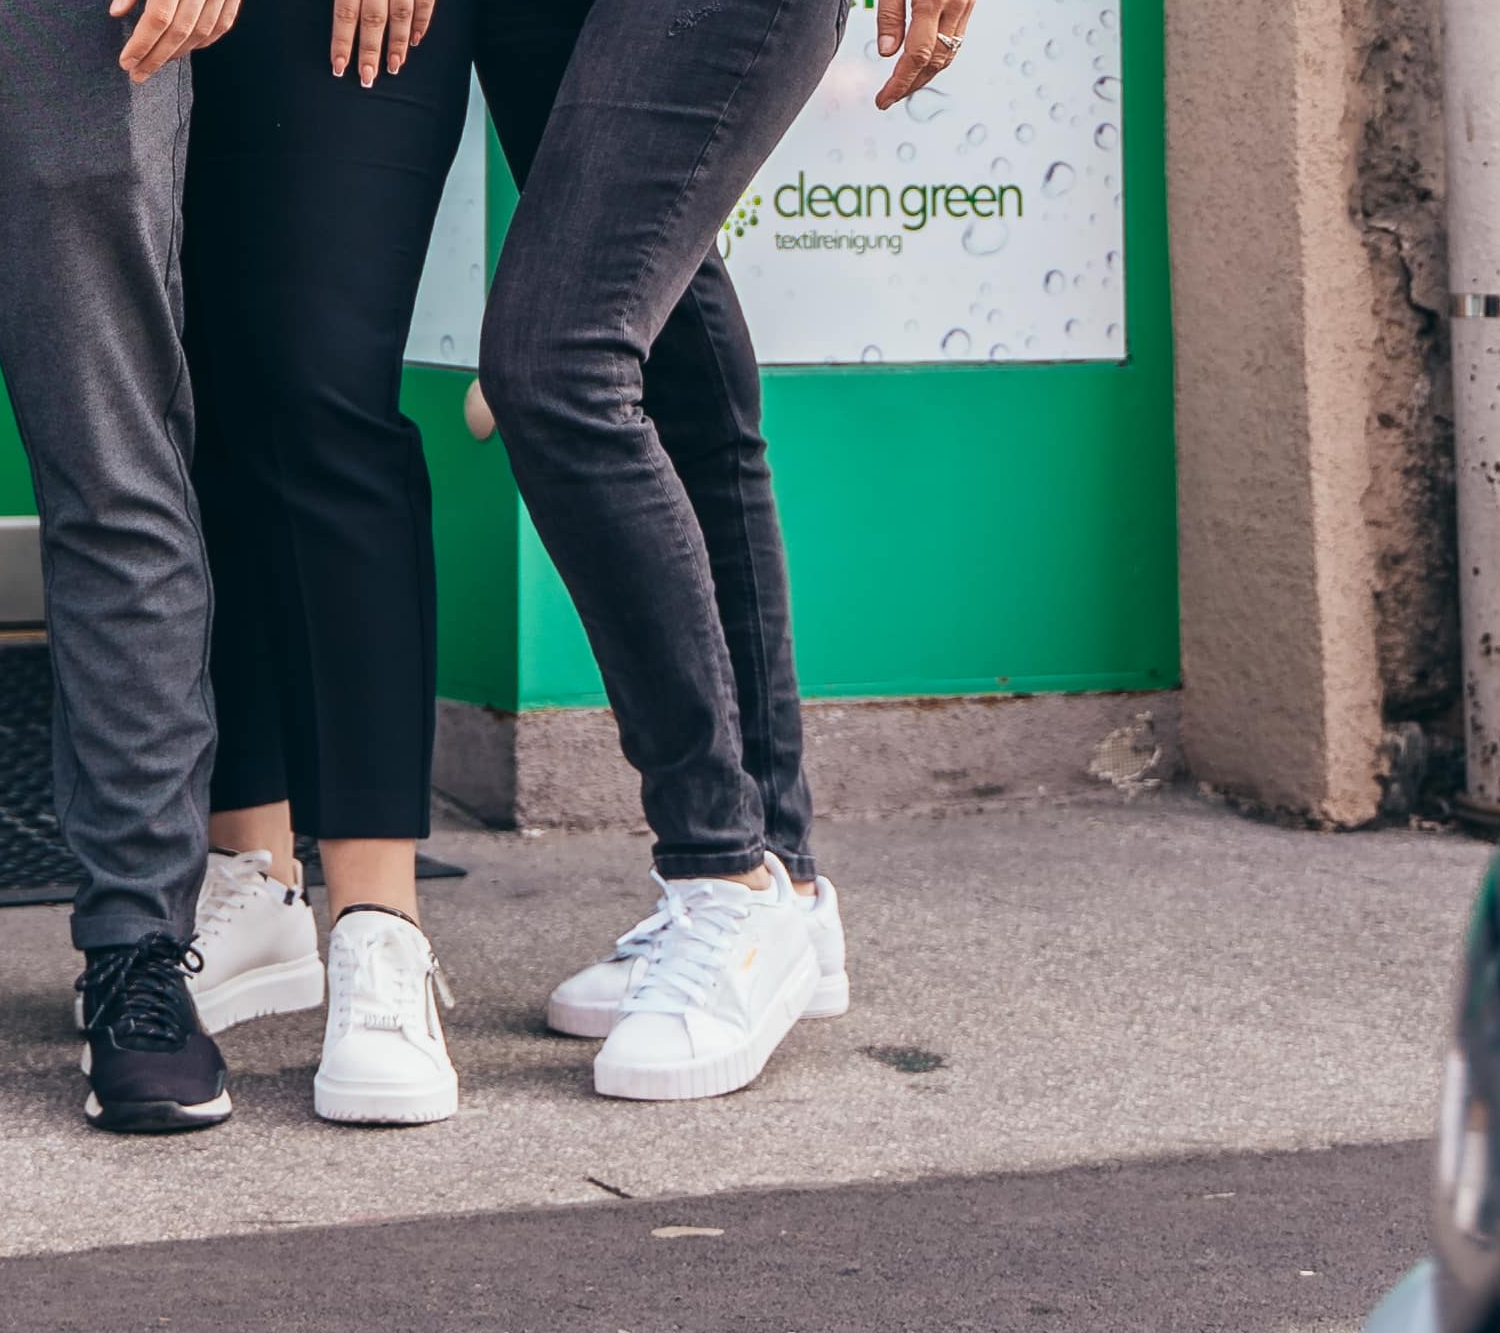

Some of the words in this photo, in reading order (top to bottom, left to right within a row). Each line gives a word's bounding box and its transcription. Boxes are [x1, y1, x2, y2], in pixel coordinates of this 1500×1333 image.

[774, 170, 892, 219] clean
[899, 184, 1024, 232] green
[775, 229, 904, 255] textilreinigung
